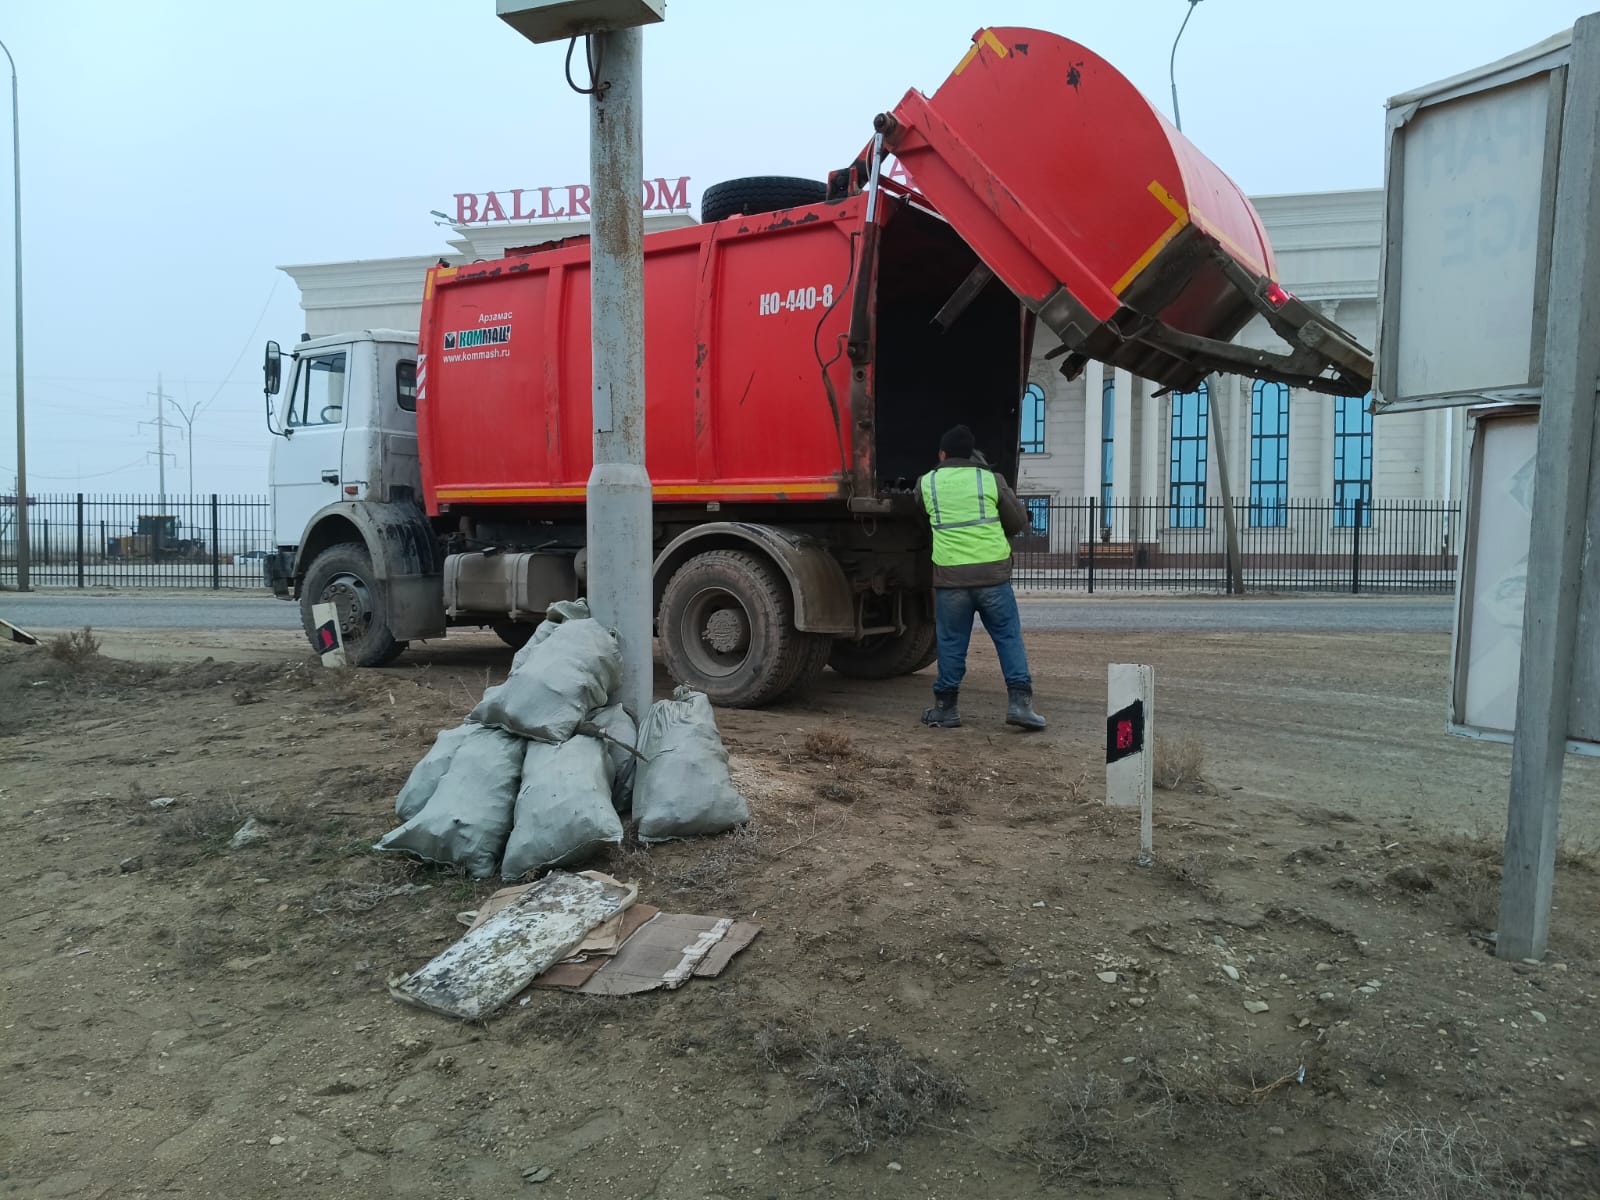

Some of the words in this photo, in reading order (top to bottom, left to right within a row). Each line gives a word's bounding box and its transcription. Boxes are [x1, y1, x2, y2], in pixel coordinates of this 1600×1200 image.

[453, 176, 691, 224] BALLRM
[759, 284, 833, 316] КО-440-8
[478, 311, 513, 324] Арзамас
[443, 348, 511, 364] www.kommash.ru
